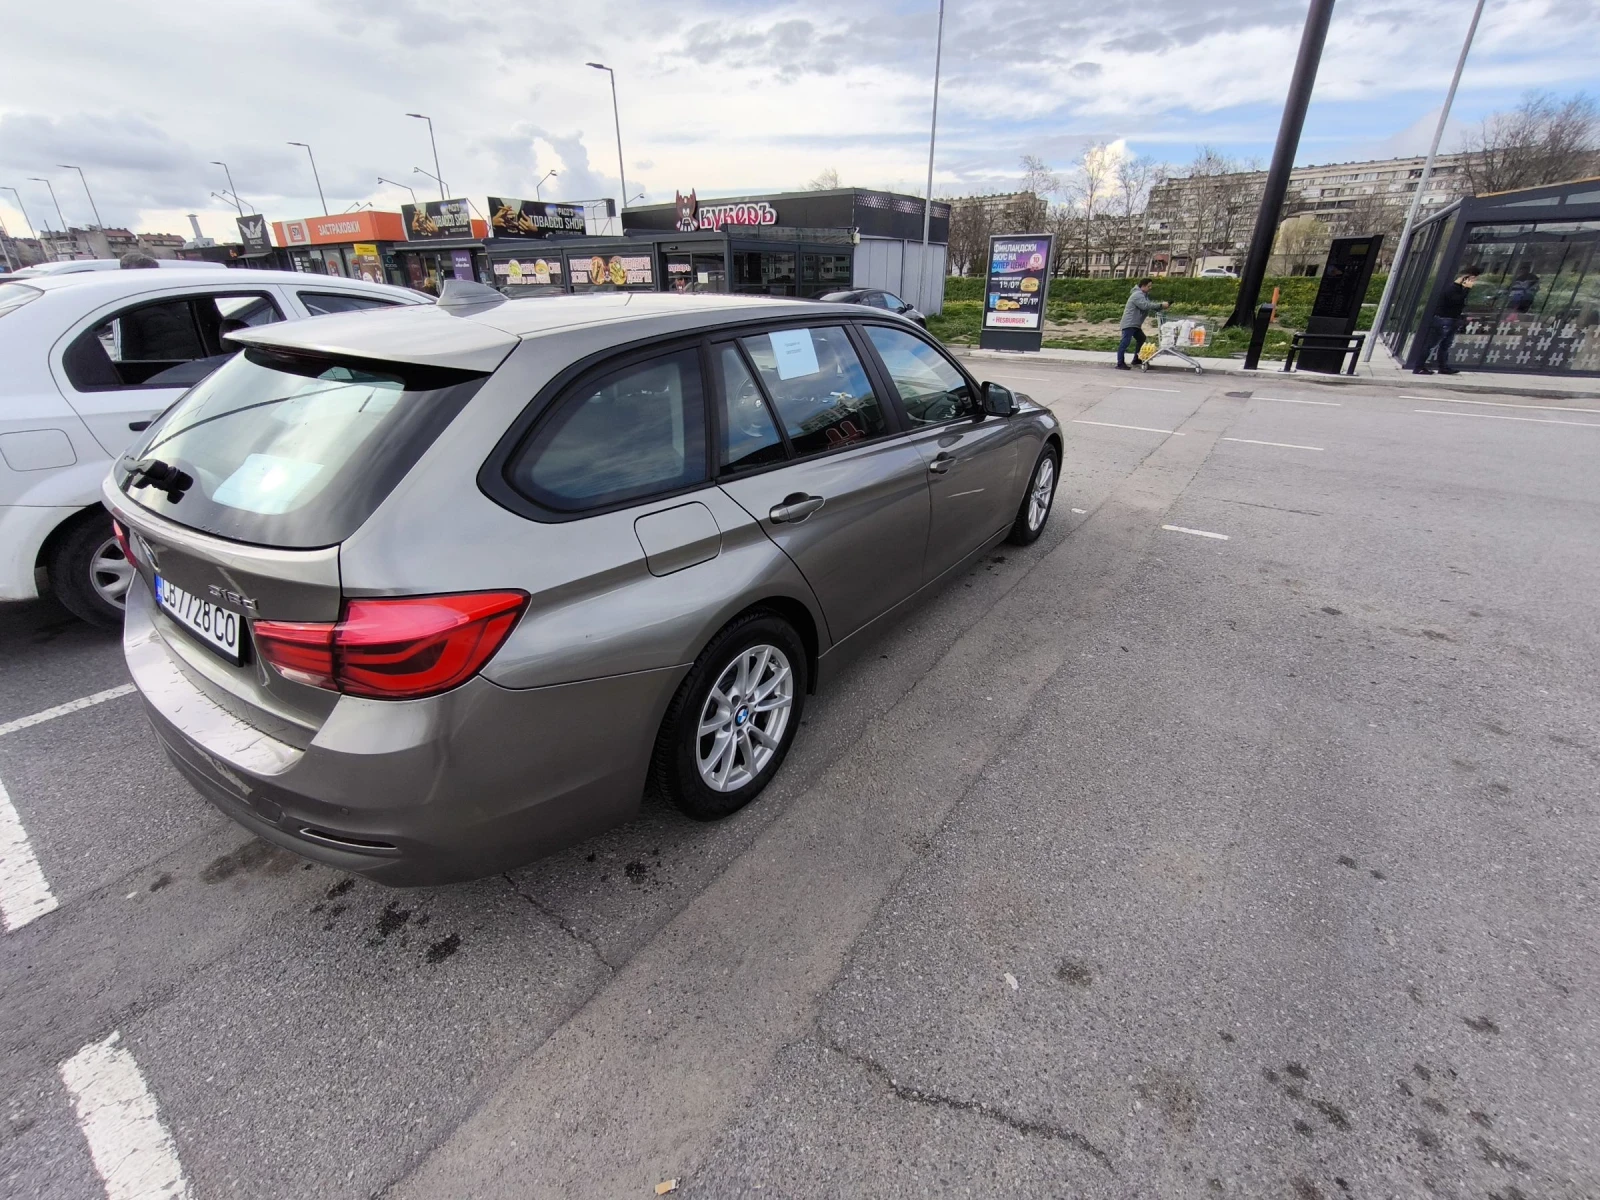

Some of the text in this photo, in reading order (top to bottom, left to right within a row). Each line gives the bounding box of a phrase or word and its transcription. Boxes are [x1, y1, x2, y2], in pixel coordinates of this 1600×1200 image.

[558, 207, 574, 216] PACO'S
[529, 214, 584, 230] TOBACCO SHOP
[317, 221, 361, 236] ЗАСТРАХОВКИ
[993, 244, 1037, 253] ФИНЛАНДСКИ
[993, 253, 1017, 261] ВКУС НА
[992, 261, 1028, 270] СУПЕР ЦЕНА!
